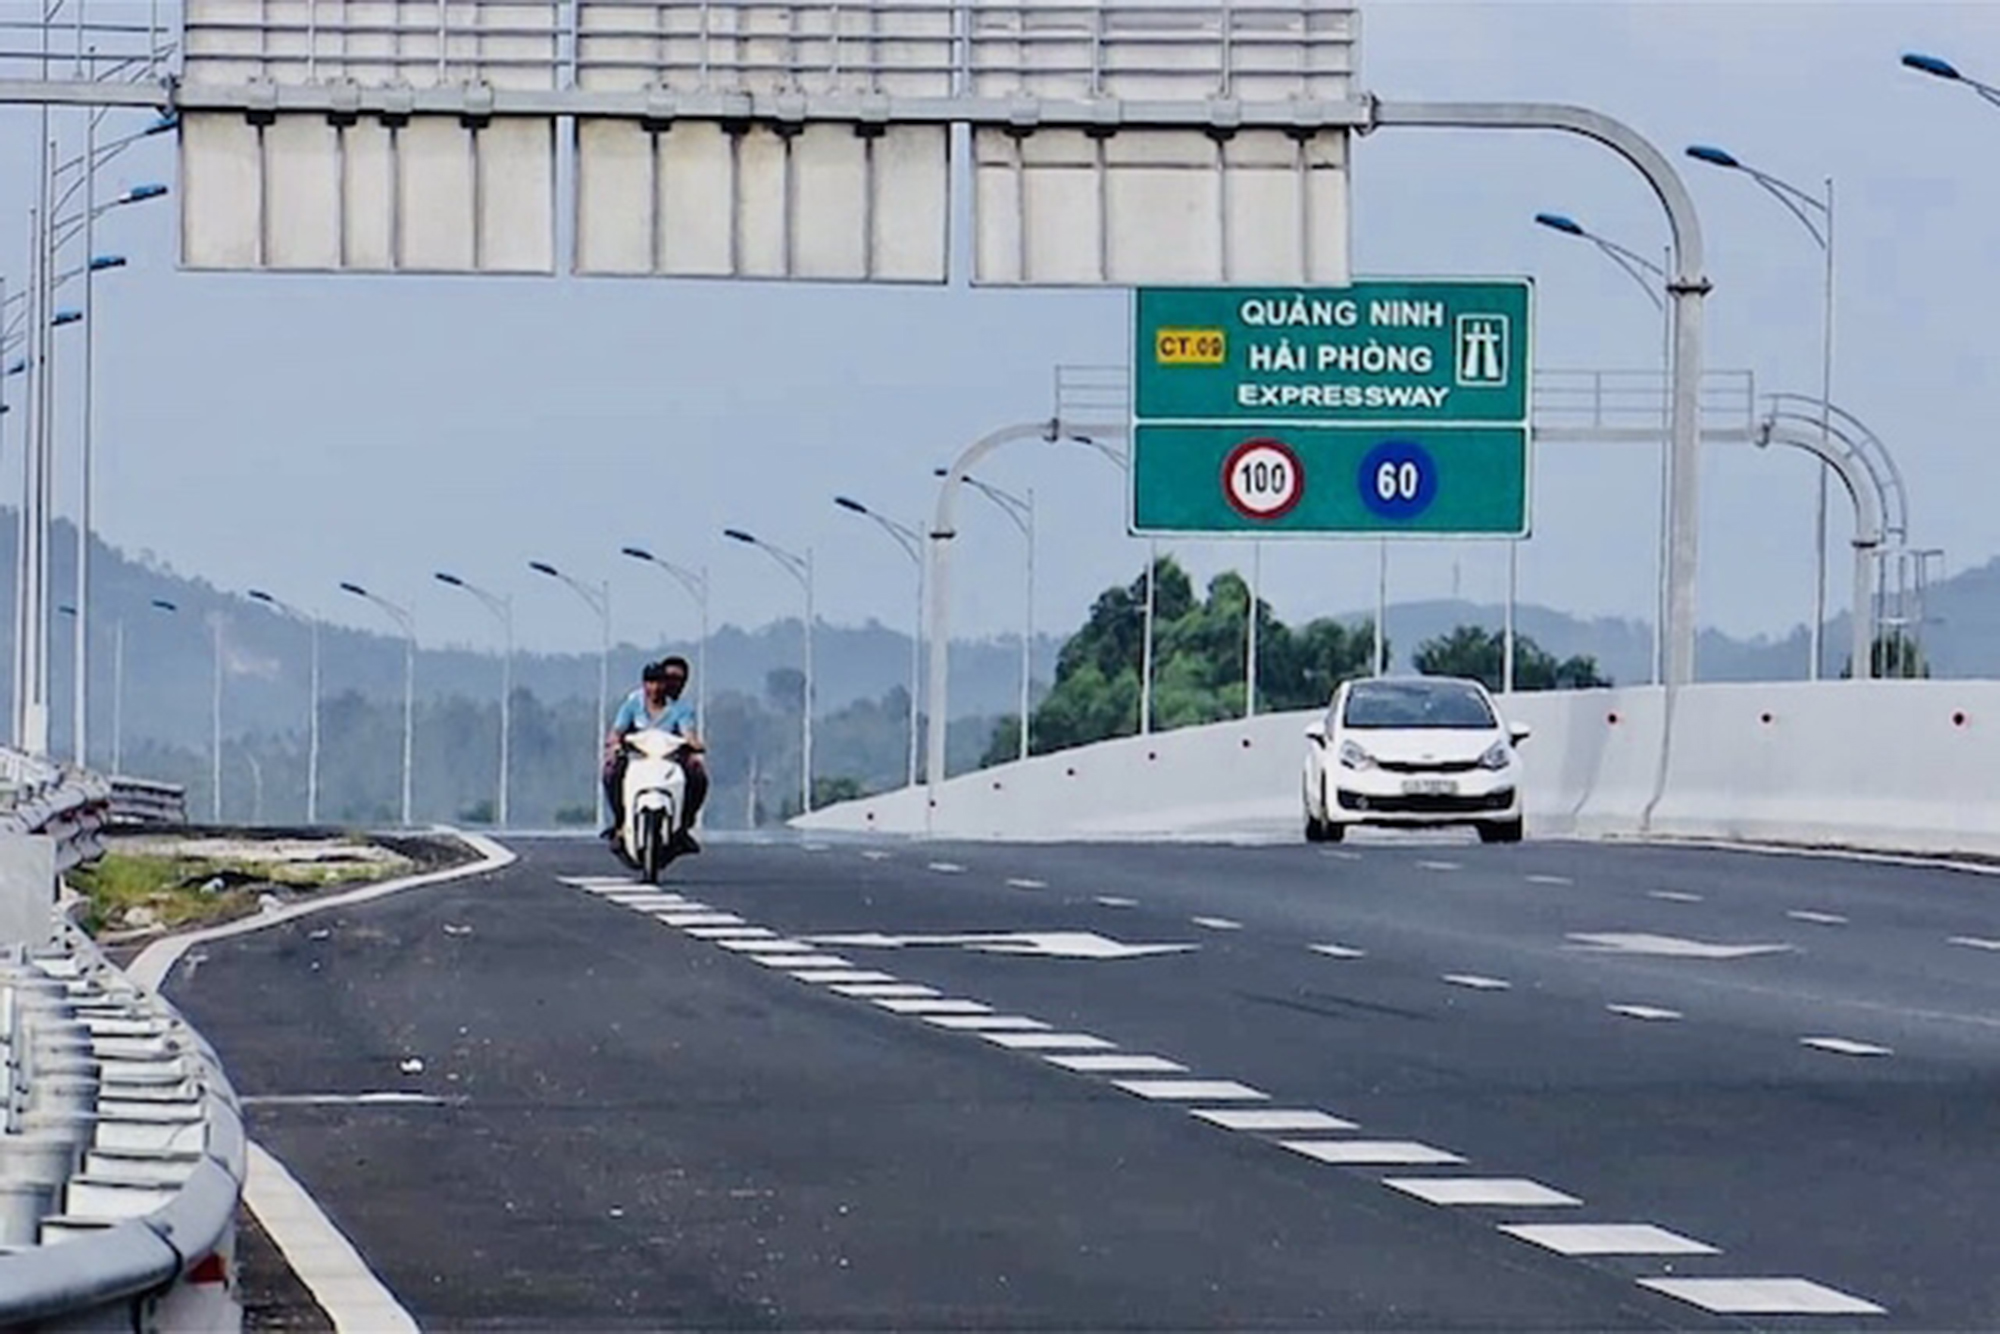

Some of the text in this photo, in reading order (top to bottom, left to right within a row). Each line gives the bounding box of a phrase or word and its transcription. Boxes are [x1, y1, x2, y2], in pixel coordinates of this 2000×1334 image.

[1241, 293, 1444, 327] QUẢNG NINH
[1250, 338, 1433, 373] HẢI PHÒNG
[1238, 384, 1449, 407] EXPRESSWAY
[1241, 461, 1286, 494] 100
[1377, 462, 1418, 499] 60
